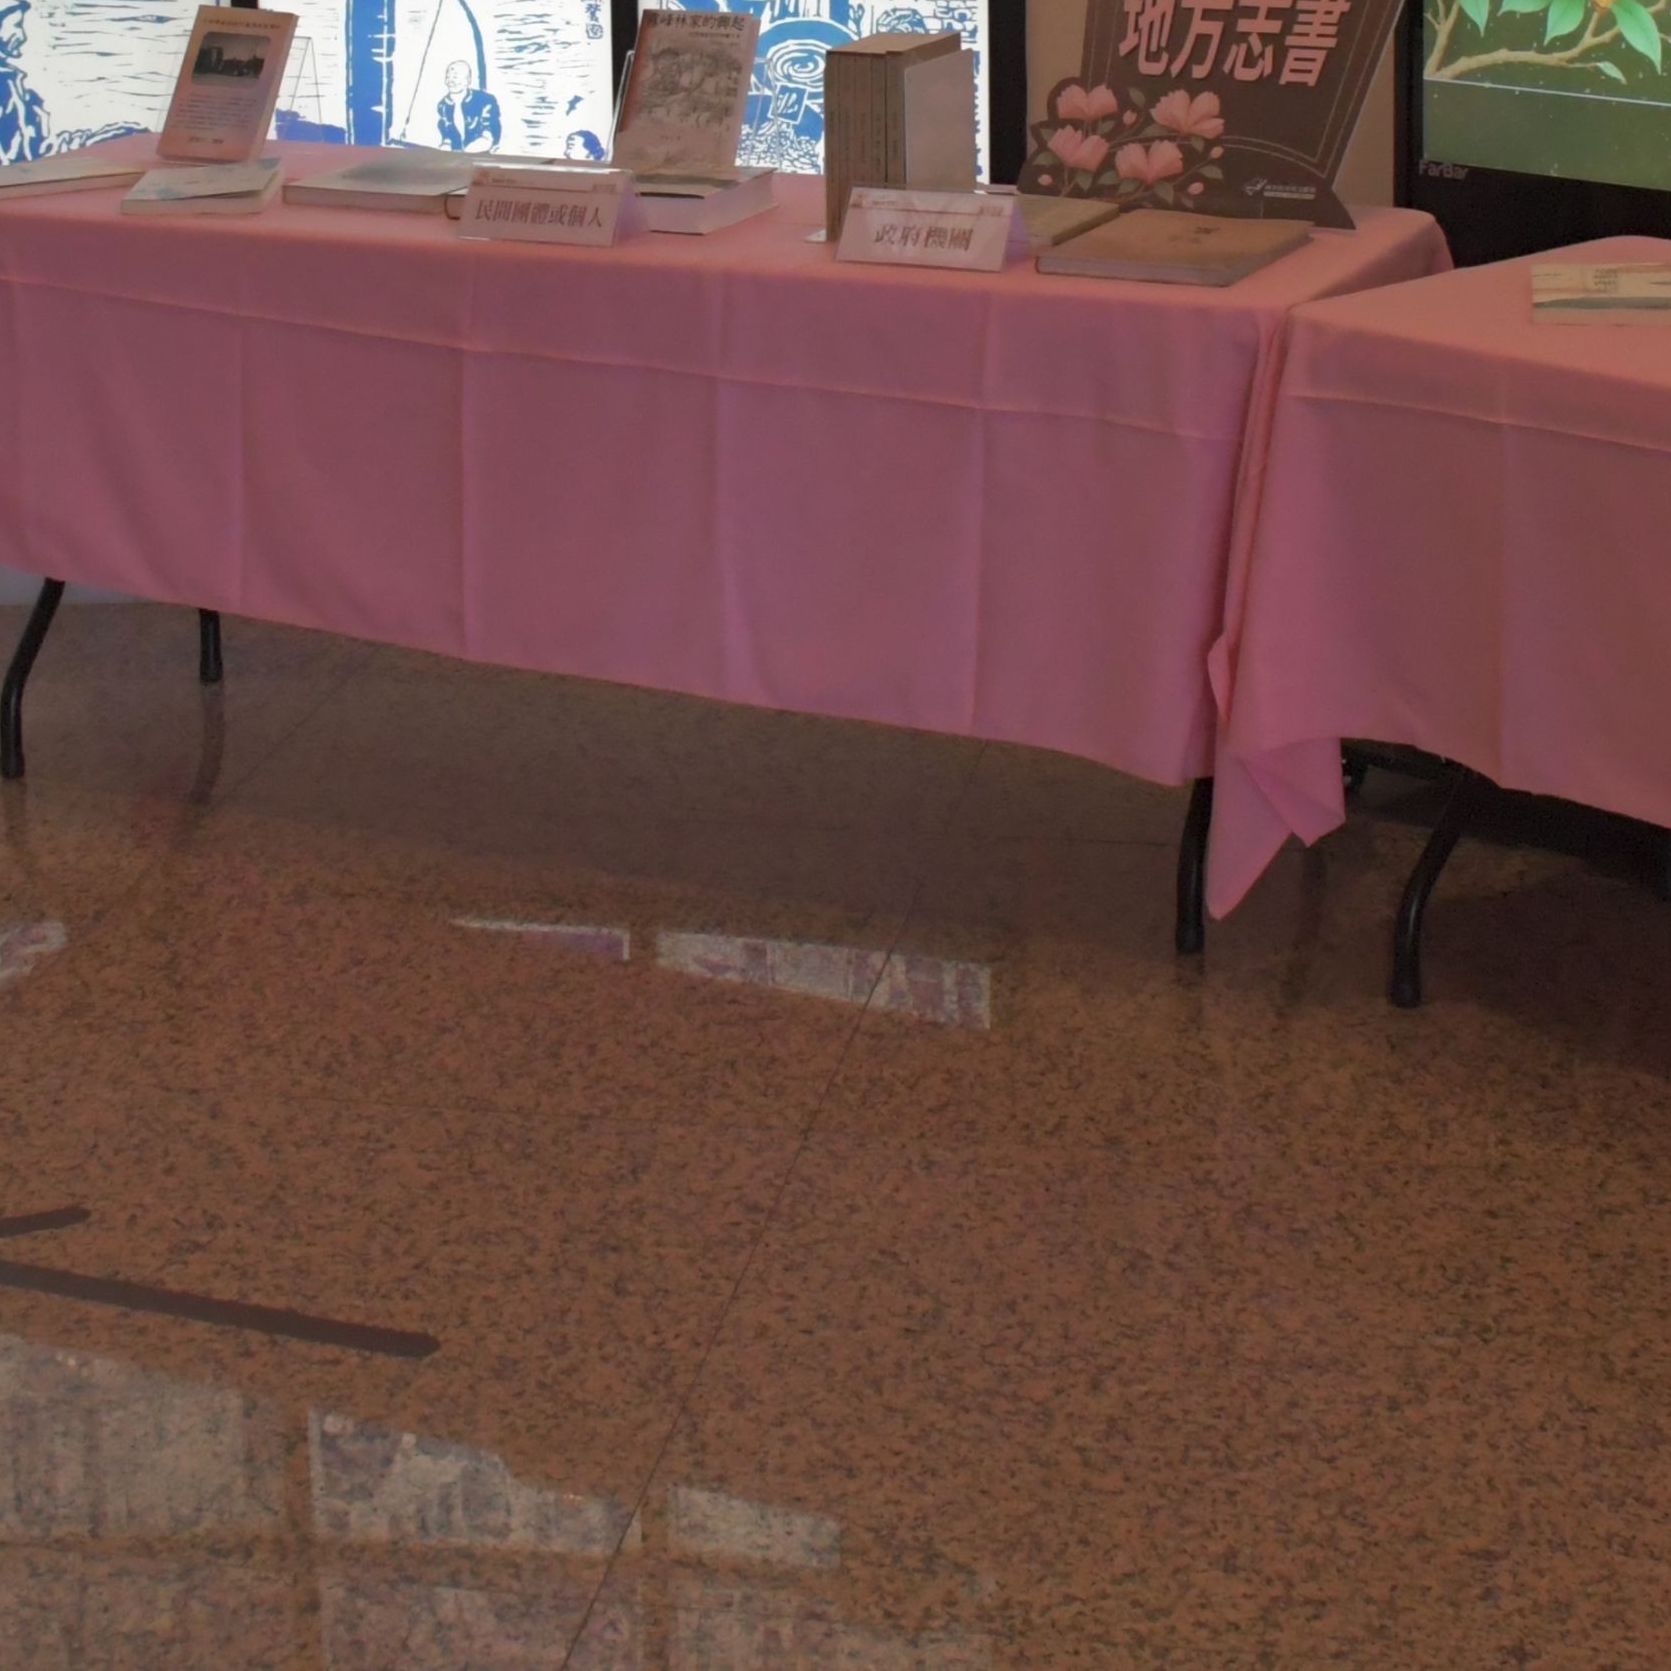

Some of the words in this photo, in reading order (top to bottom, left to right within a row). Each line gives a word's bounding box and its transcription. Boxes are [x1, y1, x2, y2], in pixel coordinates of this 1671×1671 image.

[474, 198, 603, 228] 民間團體或個人
[874, 223, 974, 251] 政府機關
